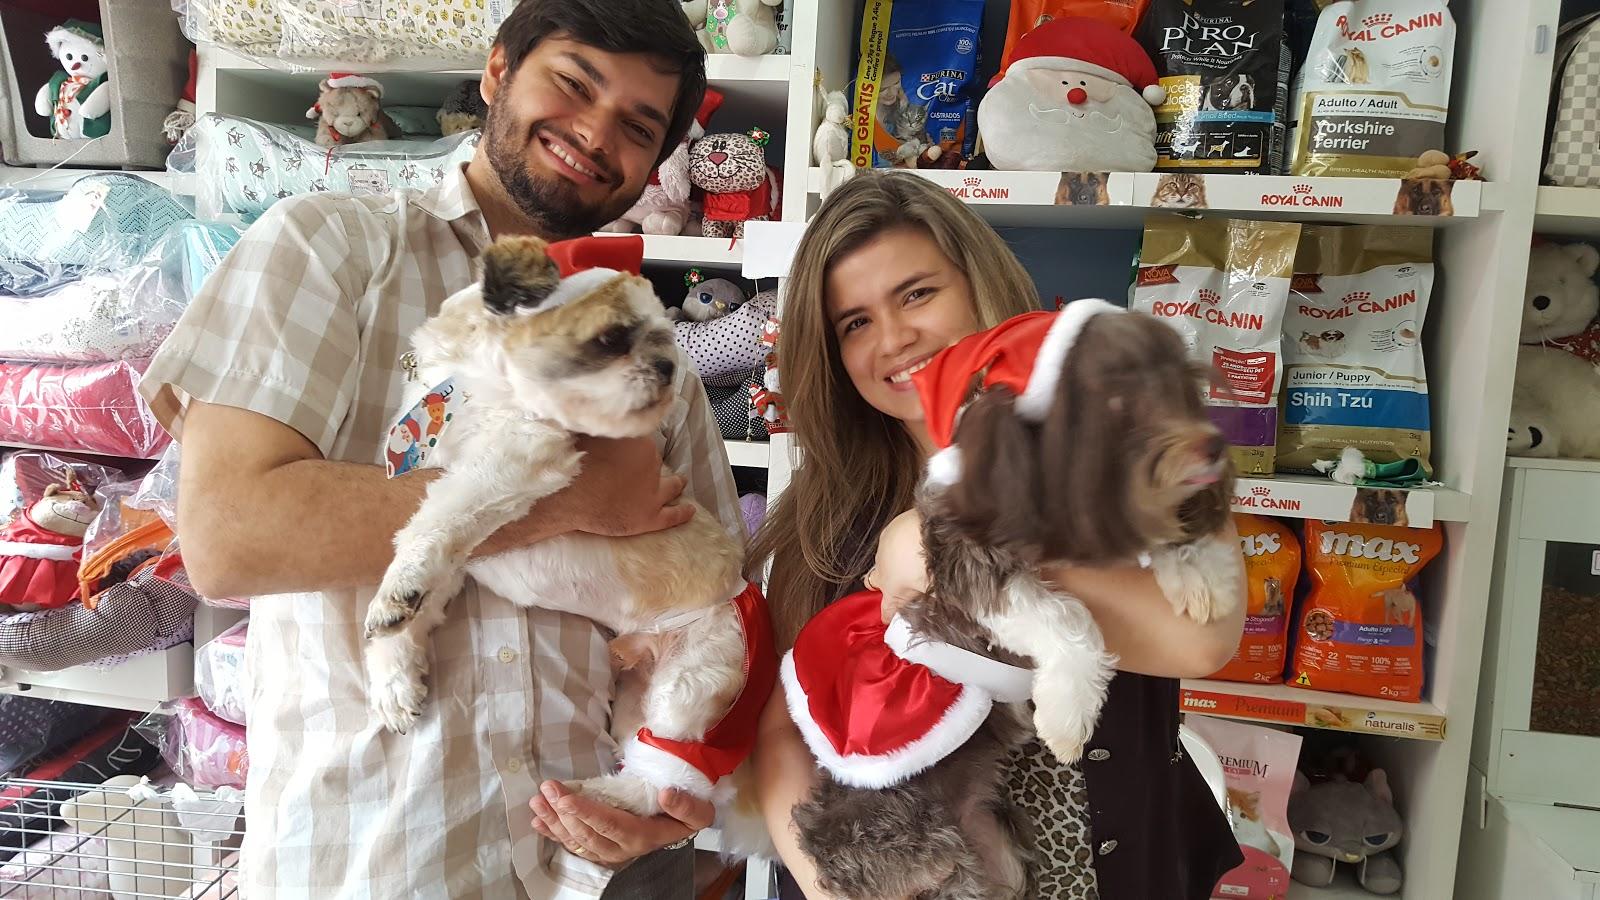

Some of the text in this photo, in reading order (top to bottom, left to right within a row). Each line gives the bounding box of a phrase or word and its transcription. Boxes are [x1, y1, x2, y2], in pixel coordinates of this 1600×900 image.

[869, 22, 878, 43] Pague
[1381, 12, 1442, 39] CANIN
[1160, 27, 1260, 56] PLAN
[931, 70, 963, 81] PURINA
[916, 80, 956, 100] Cat
[858, 82, 874, 140] GRÁTIS
[1318, 98, 1398, 109] Adulto / Adult
[1316, 119, 1395, 136] Yorkshire
[1314, 134, 1370, 150] Terrier
[946, 188, 1009, 199] YAL CANIN
[1261, 194, 1343, 207] ROYAL CANIN
[1144, 268, 1170, 278] NOVA
[1298, 290, 1416, 320] ROYAL CANIN
[1152, 300, 1263, 330] ROYAL CANIN
[1293, 370, 1370, 383] Junior / Puppy
[1291, 392, 1373, 409] Shih Tzu
[1251, 449, 1265, 457] 3kg
[1230, 496, 1301, 511] OYAL CANIN
[1240, 533, 1281, 557] ax
[1320, 530, 1420, 565] max
[1330, 560, 1410, 576] Premium Especial
[1184, 697, 1217, 709] max
[1234, 698, 1301, 718] Premium
[1365, 718, 1416, 732] naturalis
[1218, 755, 1269, 778] REMIUM
